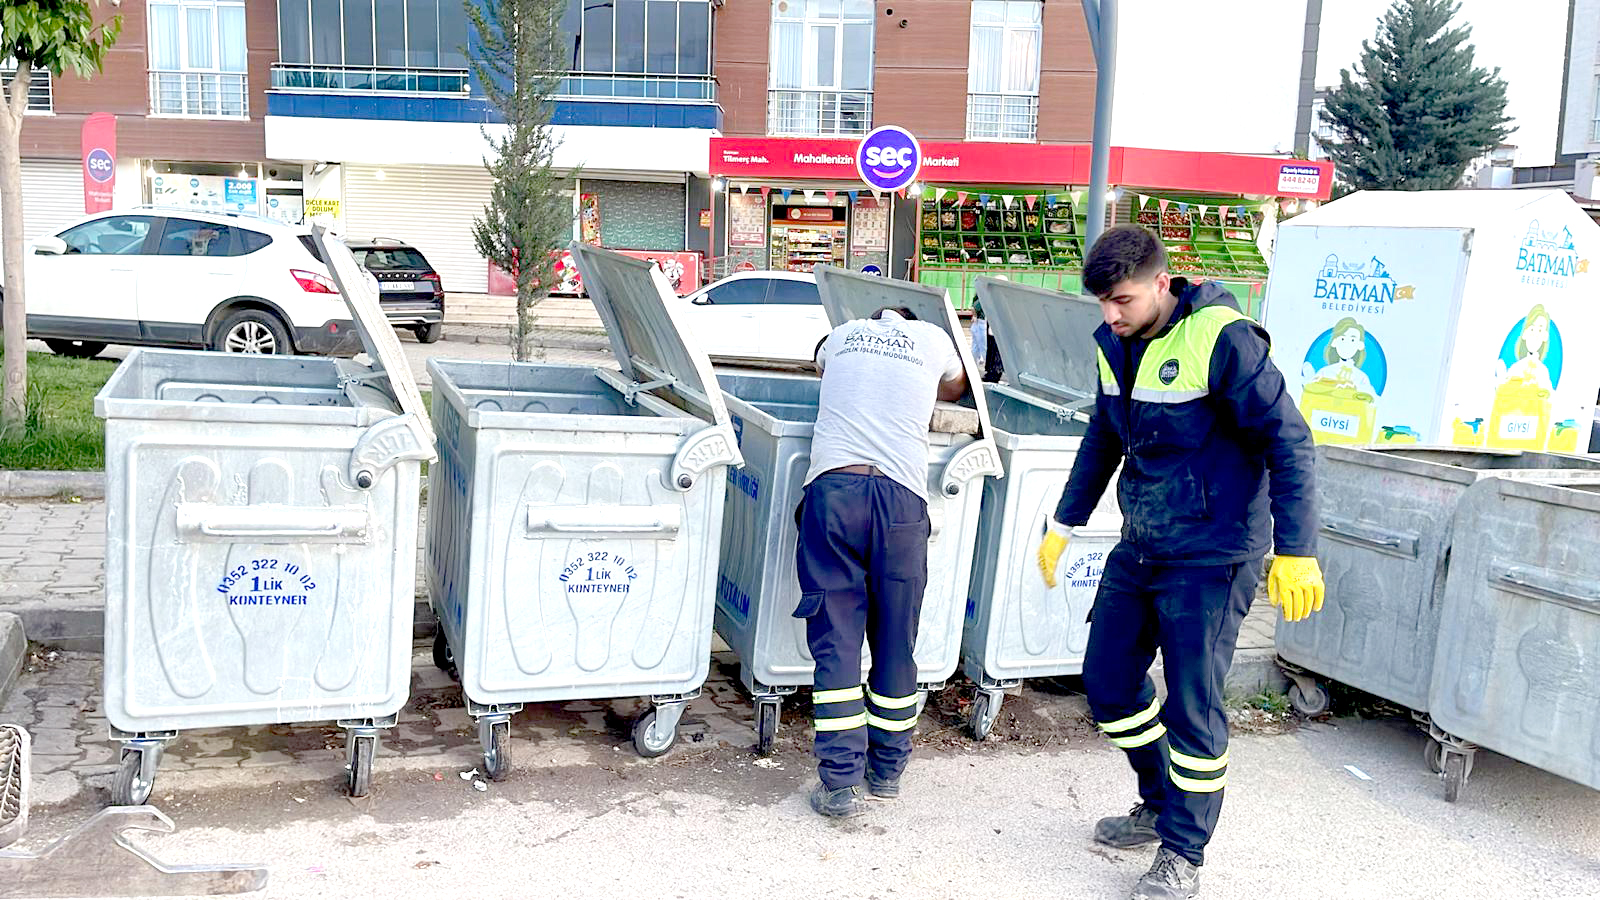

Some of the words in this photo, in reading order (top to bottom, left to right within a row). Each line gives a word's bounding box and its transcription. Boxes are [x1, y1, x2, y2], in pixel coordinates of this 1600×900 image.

[723, 155, 750, 164] Tilmerç
[751, 156, 769, 164] Mah.
[793, 153, 854, 165] Mahallenizin
[865, 146, 913, 169] seç
[922, 157, 960, 167] Marketi
[1516, 247, 1578, 278] BATMAN
[1313, 278, 1397, 304] BATMAN
[1321, 302, 1385, 315] BELEDİYESİ
[844, 334, 915, 351] BATMAN
[1320, 416, 1350, 431] GİYSİ
[1507, 420, 1531, 433] GİYSİ
[587, 551, 609, 562] 322
[1087, 552, 1103, 561] 322
[251, 558, 279, 571] 322
[568, 583, 630, 593] KONTEYNER
[229, 595, 307, 605] KONTEYNER
